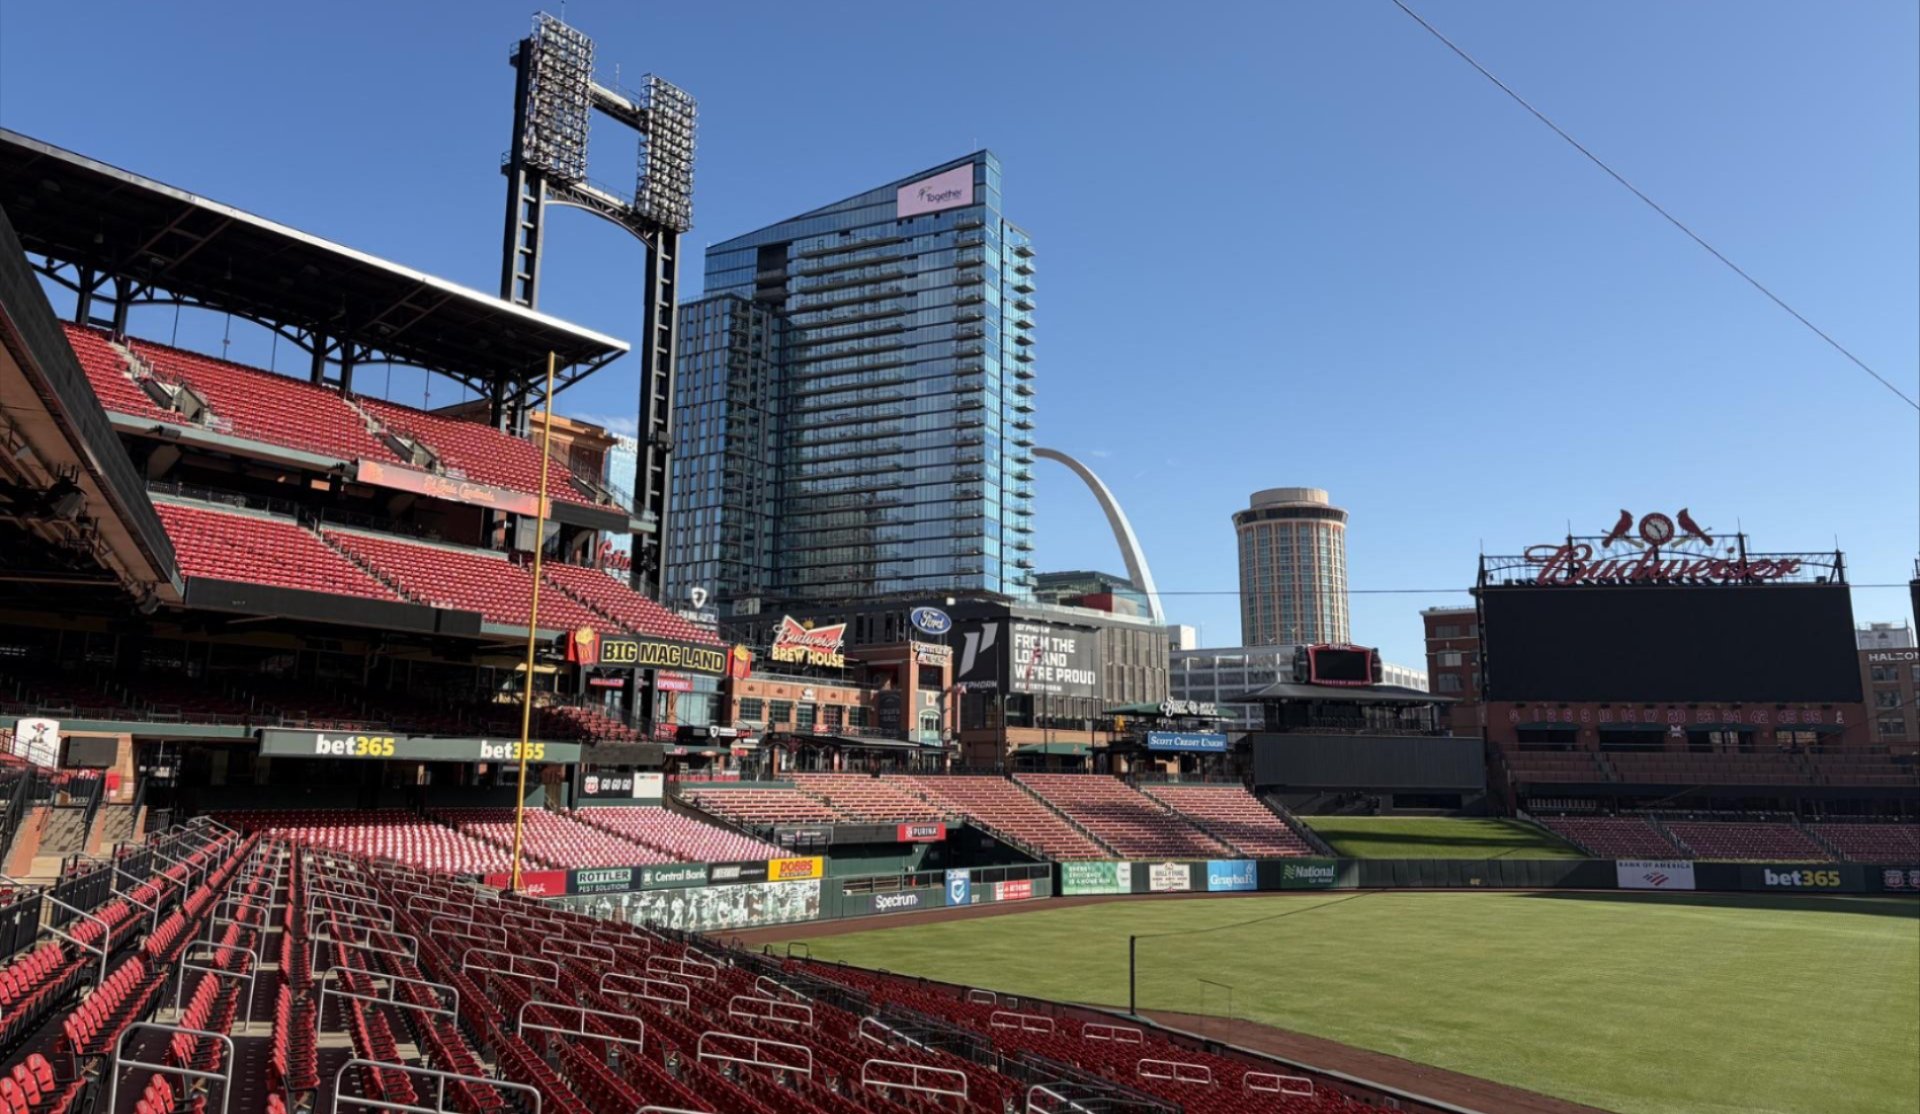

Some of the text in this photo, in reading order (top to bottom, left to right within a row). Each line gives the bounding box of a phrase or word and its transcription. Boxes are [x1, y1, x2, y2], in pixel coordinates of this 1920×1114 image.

[926, 189, 963, 203] Together
[1525, 545, 1800, 586] Budweiser
[920, 611, 944, 628] Ford
[773, 624, 844, 648] Budweiser
[1015, 633, 1075, 653] FROM THE
[601, 641, 725, 673] BIG MAC LAND
[772, 645, 844, 668] BREW HOUSE
[1041, 651, 1067, 667] AND
[1015, 664, 1096, 685] WE'RE PROUD
[315, 734, 395, 757] bet365
[480, 740, 545, 760] bet365
[912, 827, 937, 836] PURINA
[655, 870, 684, 882] Central
[685, 868, 706, 879] Bank
[779, 860, 813, 872] DOBBS
[1296, 865, 1334, 877] National
[579, 870, 629, 883] ROTTLER
[1764, 869, 1840, 886] bet365
[875, 891, 917, 910] Spectrum
